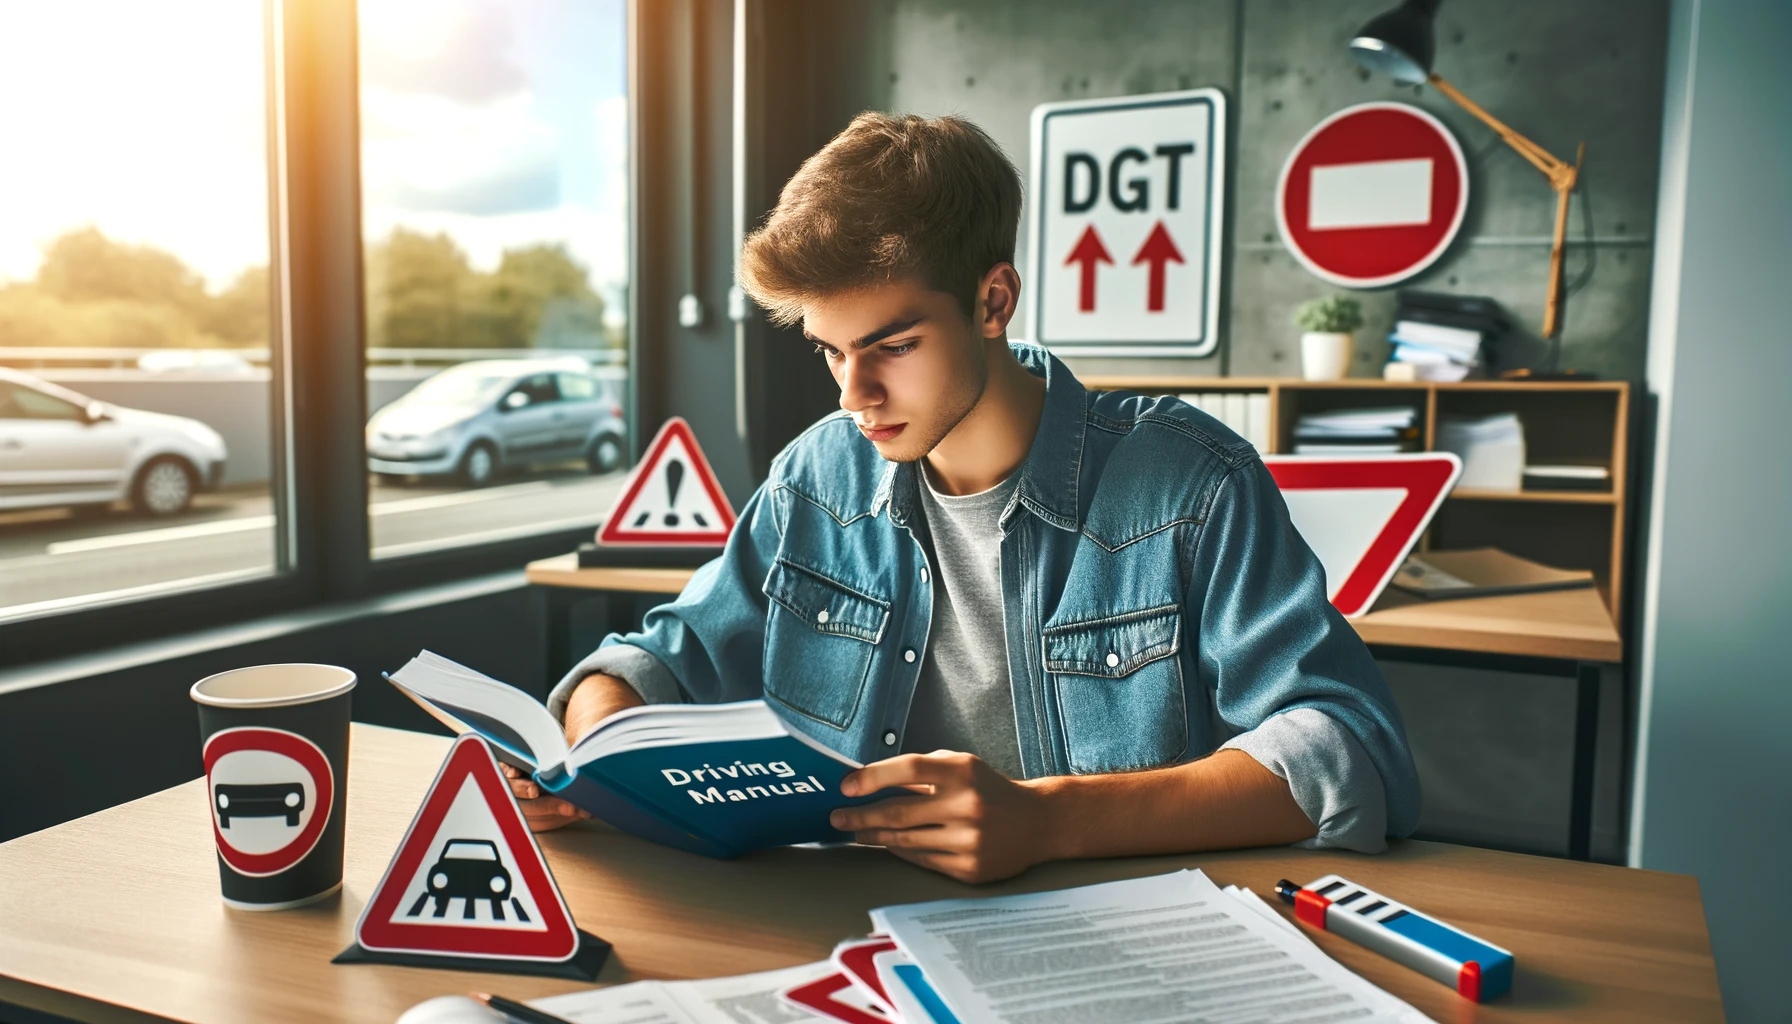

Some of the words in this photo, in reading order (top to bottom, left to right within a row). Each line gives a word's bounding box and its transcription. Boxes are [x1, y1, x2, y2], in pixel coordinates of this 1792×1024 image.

[1063, 143, 1195, 214] DGT
[660, 760, 796, 787] Driving
[687, 775, 826, 805] Manual
